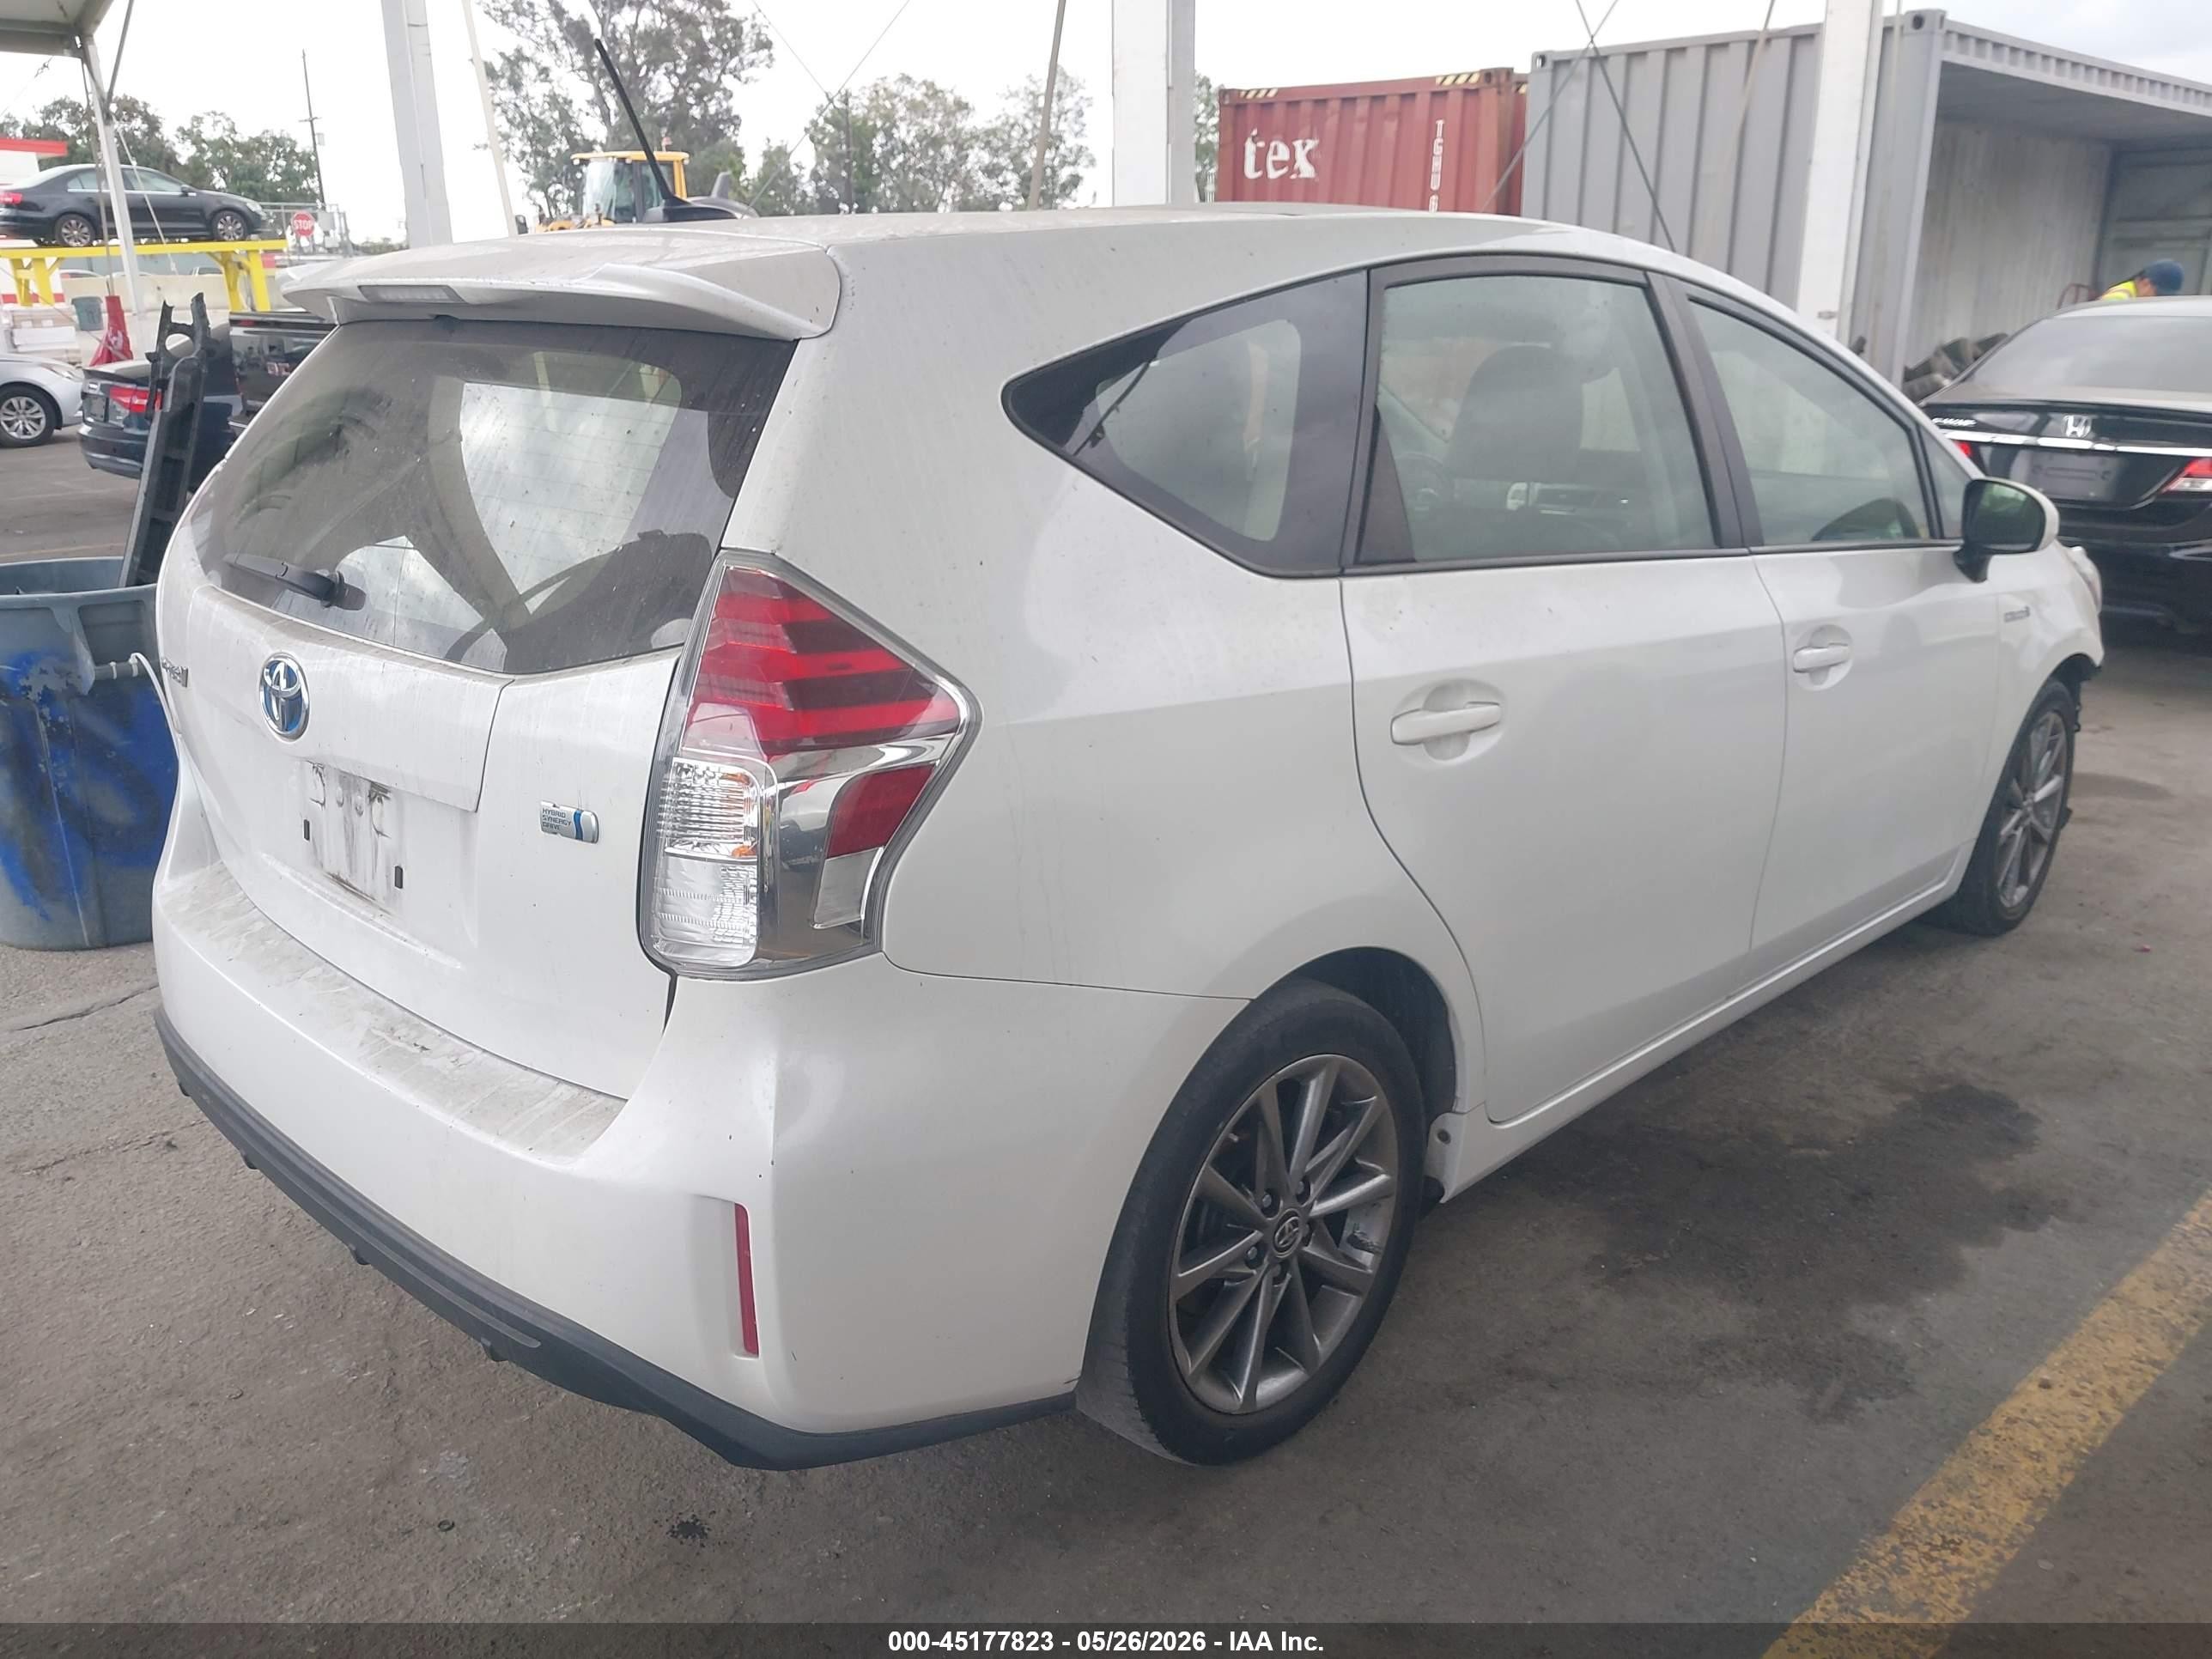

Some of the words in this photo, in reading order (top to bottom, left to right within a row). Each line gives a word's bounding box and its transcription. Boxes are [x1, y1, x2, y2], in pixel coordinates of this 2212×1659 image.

[1243, 127, 1320, 179] tex
[293, 219, 313, 230] STOP
[542, 807, 567, 818] HYBRID
[542, 814, 572, 826] SYNERGY
[542, 821, 561, 830] DRIVE
